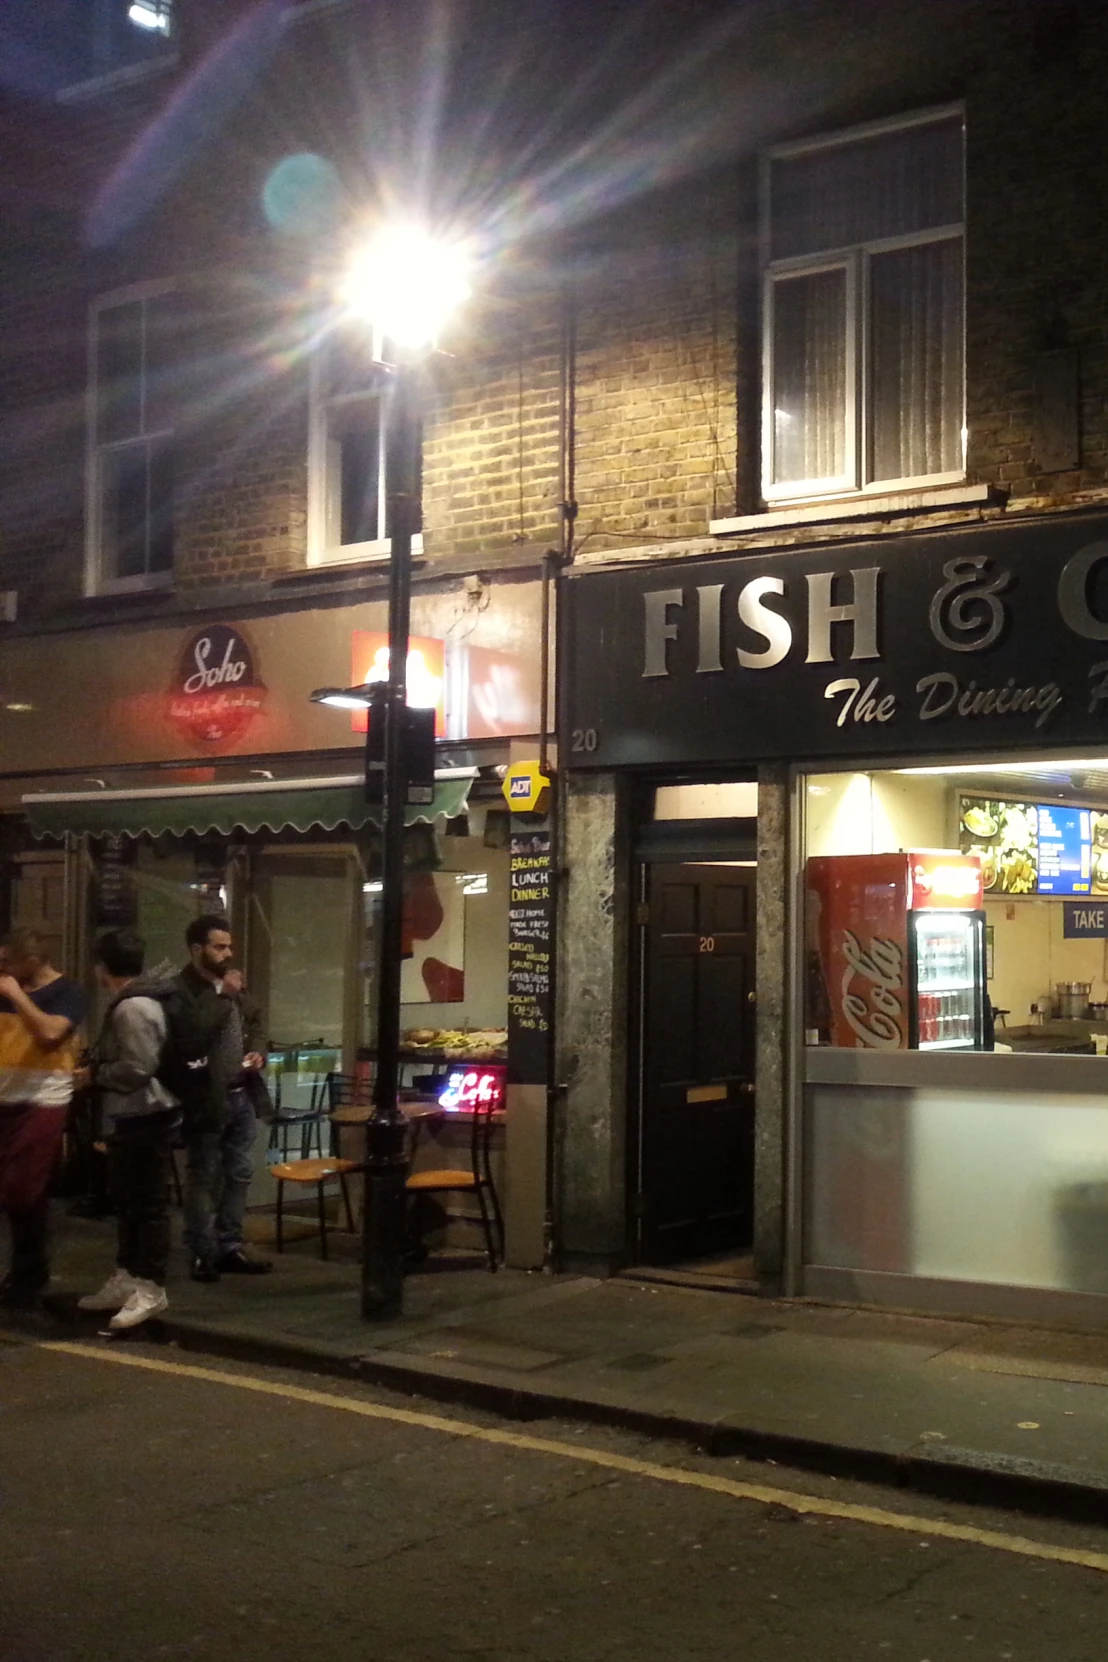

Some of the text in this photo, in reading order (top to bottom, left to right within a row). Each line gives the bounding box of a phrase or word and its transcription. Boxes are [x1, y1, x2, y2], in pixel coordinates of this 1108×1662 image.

[642, 567, 882, 678] FISH
[930, 556, 1014, 652] &
[184, 637, 247, 694] Soho
[824, 677, 896, 728] The
[916, 672, 1062, 728] Dining
[572, 729, 598, 752] 20
[511, 778, 531, 794] ADT
[512, 872, 549, 886] LUNCH
[511, 887, 550, 901] DINNER
[1073, 910, 1104, 929] TAKE
[700, 936, 714, 953] 20
[841, 928, 904, 1049] Cola
